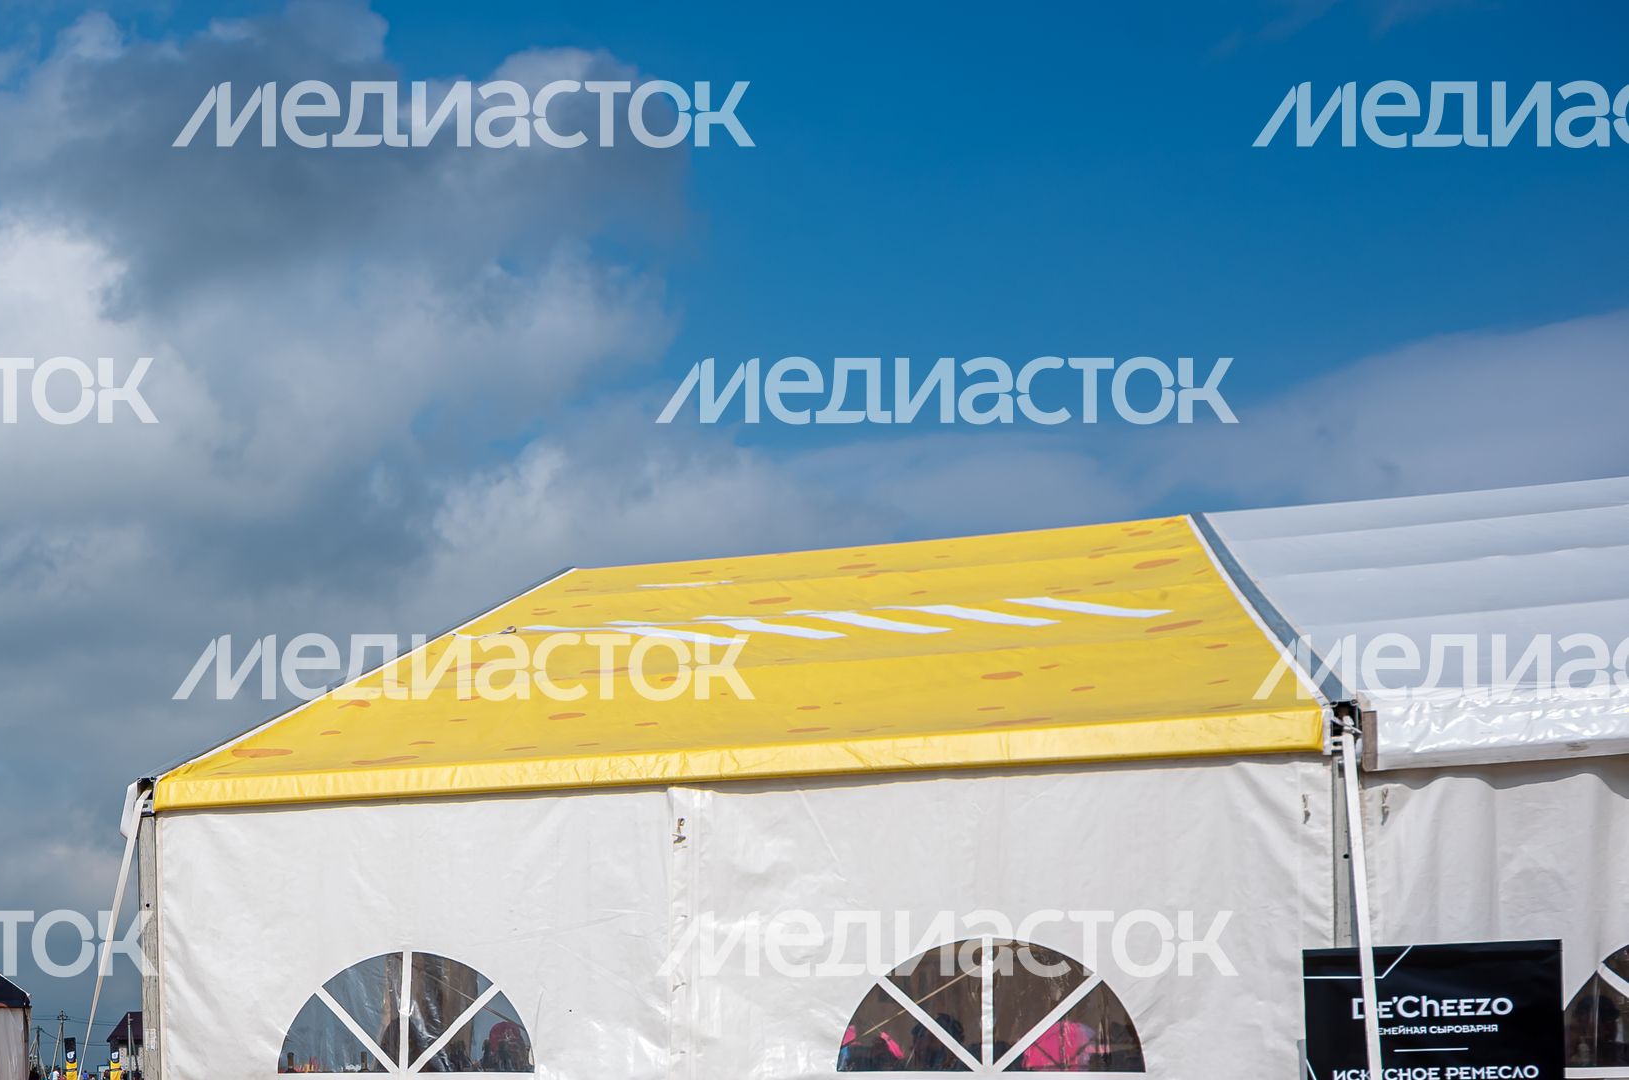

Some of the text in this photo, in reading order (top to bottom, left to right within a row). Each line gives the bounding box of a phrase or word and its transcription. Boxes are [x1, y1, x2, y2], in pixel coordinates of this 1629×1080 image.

[1378, 1024, 1499, 1035] ЕМЕЙНАЯ СЫРОВАРНЯ
[1444, 1065, 1539, 1080] РЕМЕСЛО
